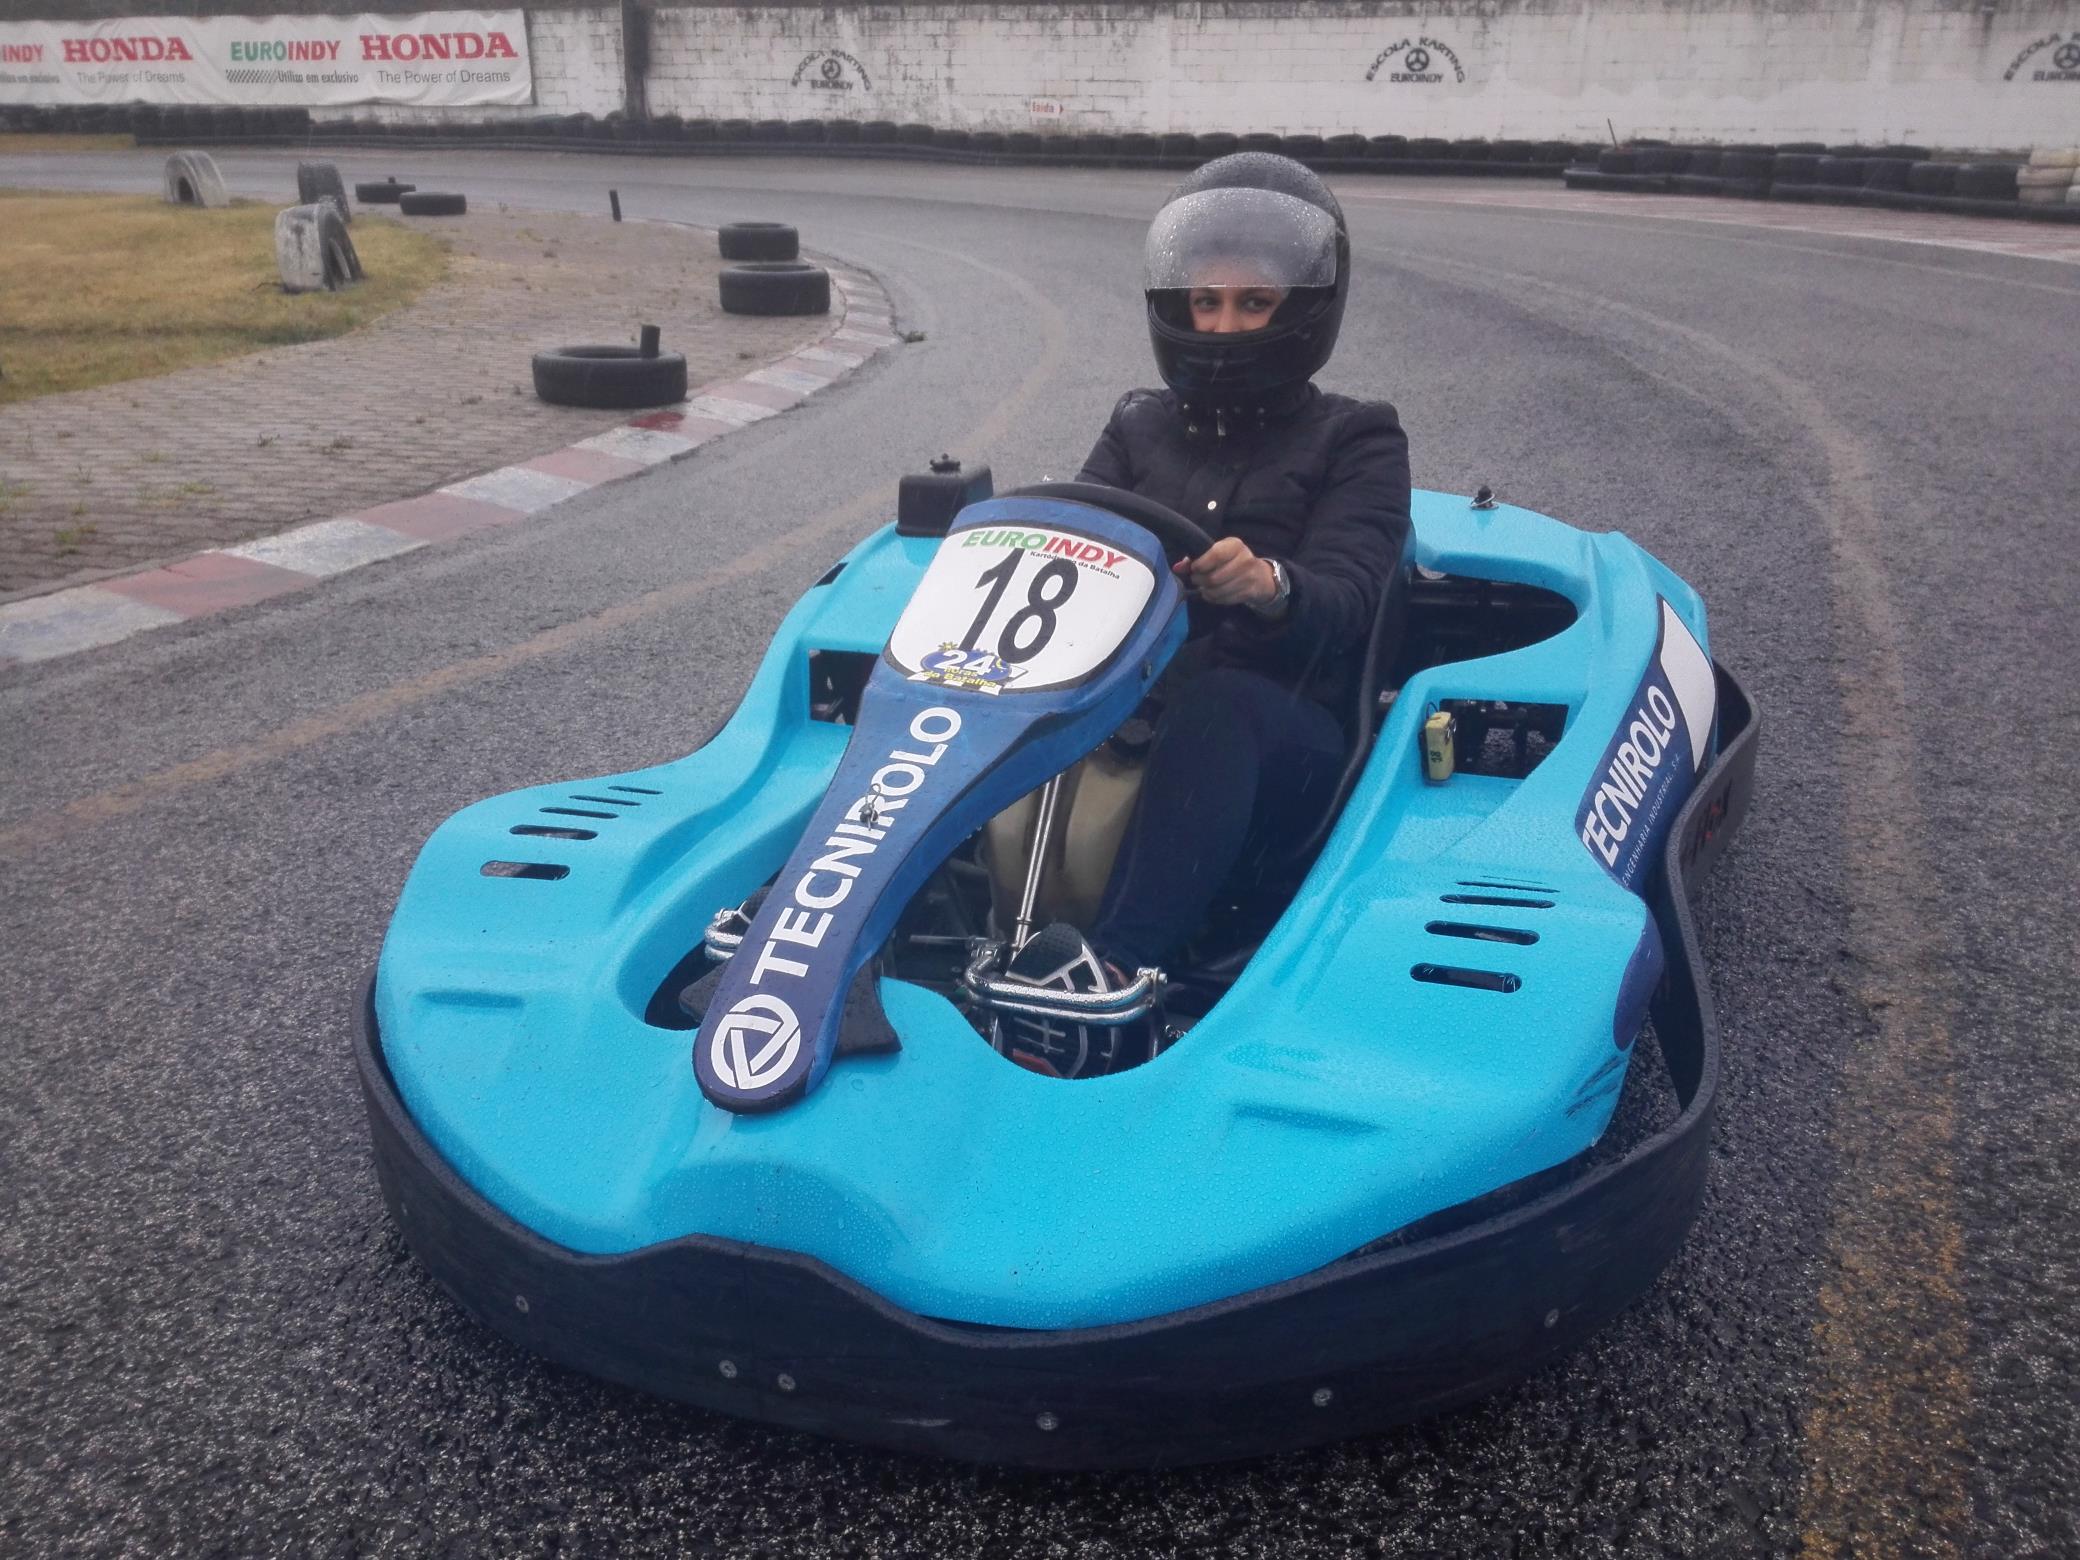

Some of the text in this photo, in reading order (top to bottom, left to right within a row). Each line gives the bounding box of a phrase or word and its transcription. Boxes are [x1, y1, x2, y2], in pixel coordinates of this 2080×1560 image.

[61, 36, 194, 63] HONDA
[230, 40, 341, 62] EUROINDY
[358, 31, 519, 62] HONDA
[1365, 36, 1466, 84] ESCOLA KARTING
[376, 69, 511, 84] The Power of Dreams
[961, 530, 1128, 569] EUROINDY
[958, 548, 1079, 664] 18
[933, 649, 996, 676] 24
[750, 706, 962, 985] TECNIROLO
[1621, 824, 1651, 887] ENGENHARIA
